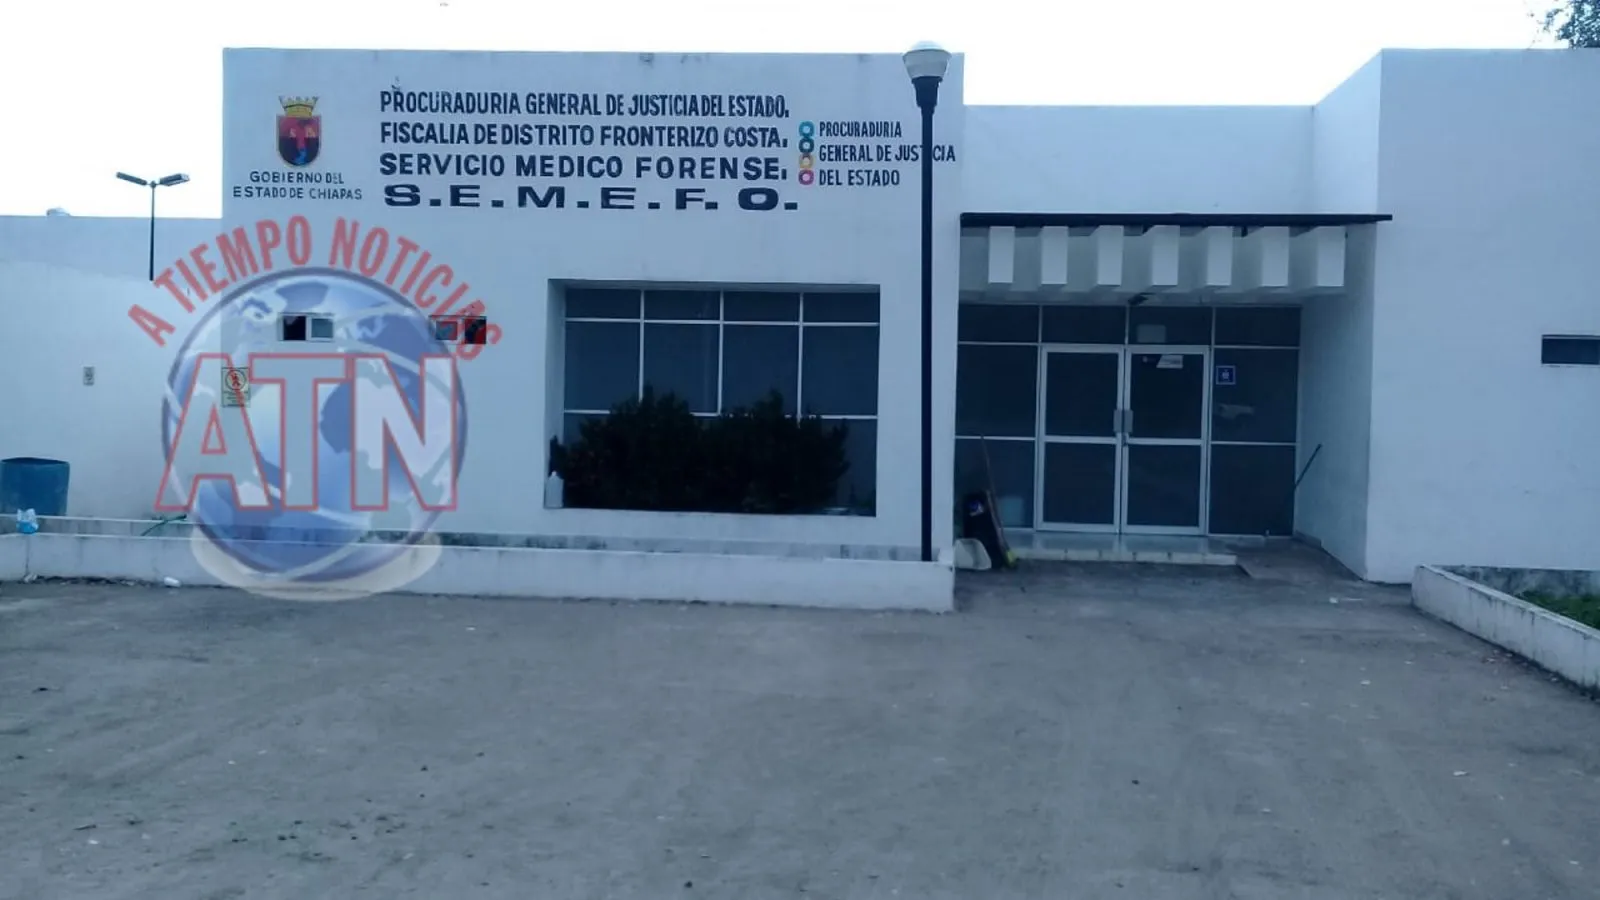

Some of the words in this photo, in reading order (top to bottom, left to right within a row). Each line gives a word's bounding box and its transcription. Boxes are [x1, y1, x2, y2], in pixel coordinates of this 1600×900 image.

[380, 91, 521, 114] PROCURADURIA
[526, 93, 601, 115] GENERAL
[606, 94, 624, 116] DE
[628, 94, 699, 117] JUSTICIA
[701, 95, 725, 117] DEL
[728, 95, 789, 118] ESTADO.
[380, 122, 469, 144] FISCALIA
[474, 123, 497, 145] DE
[501, 124, 594, 146] DISTRITO
[600, 126, 718, 148] FRONTERIZO
[723, 127, 788, 148] COSTA.
[819, 121, 902, 137] PROCURADURIA
[819, 144, 873, 162] GENERAL
[876, 145, 892, 162] DE
[895, 145, 956, 162] JUSCIA
[380, 153, 505, 176] SERVICIO
[515, 155, 623, 178] MEDICO
[636, 157, 787, 180] FORENSE.
[250, 171, 322, 183] GOBIERNO
[325, 172, 344, 184] DEL
[819, 169, 842, 186] DEL
[848, 169, 900, 186] ESTADO
[233, 186, 287, 199] ESTADO
[289, 187, 304, 199] DE
[309, 188, 362, 200] CHIAPAS
